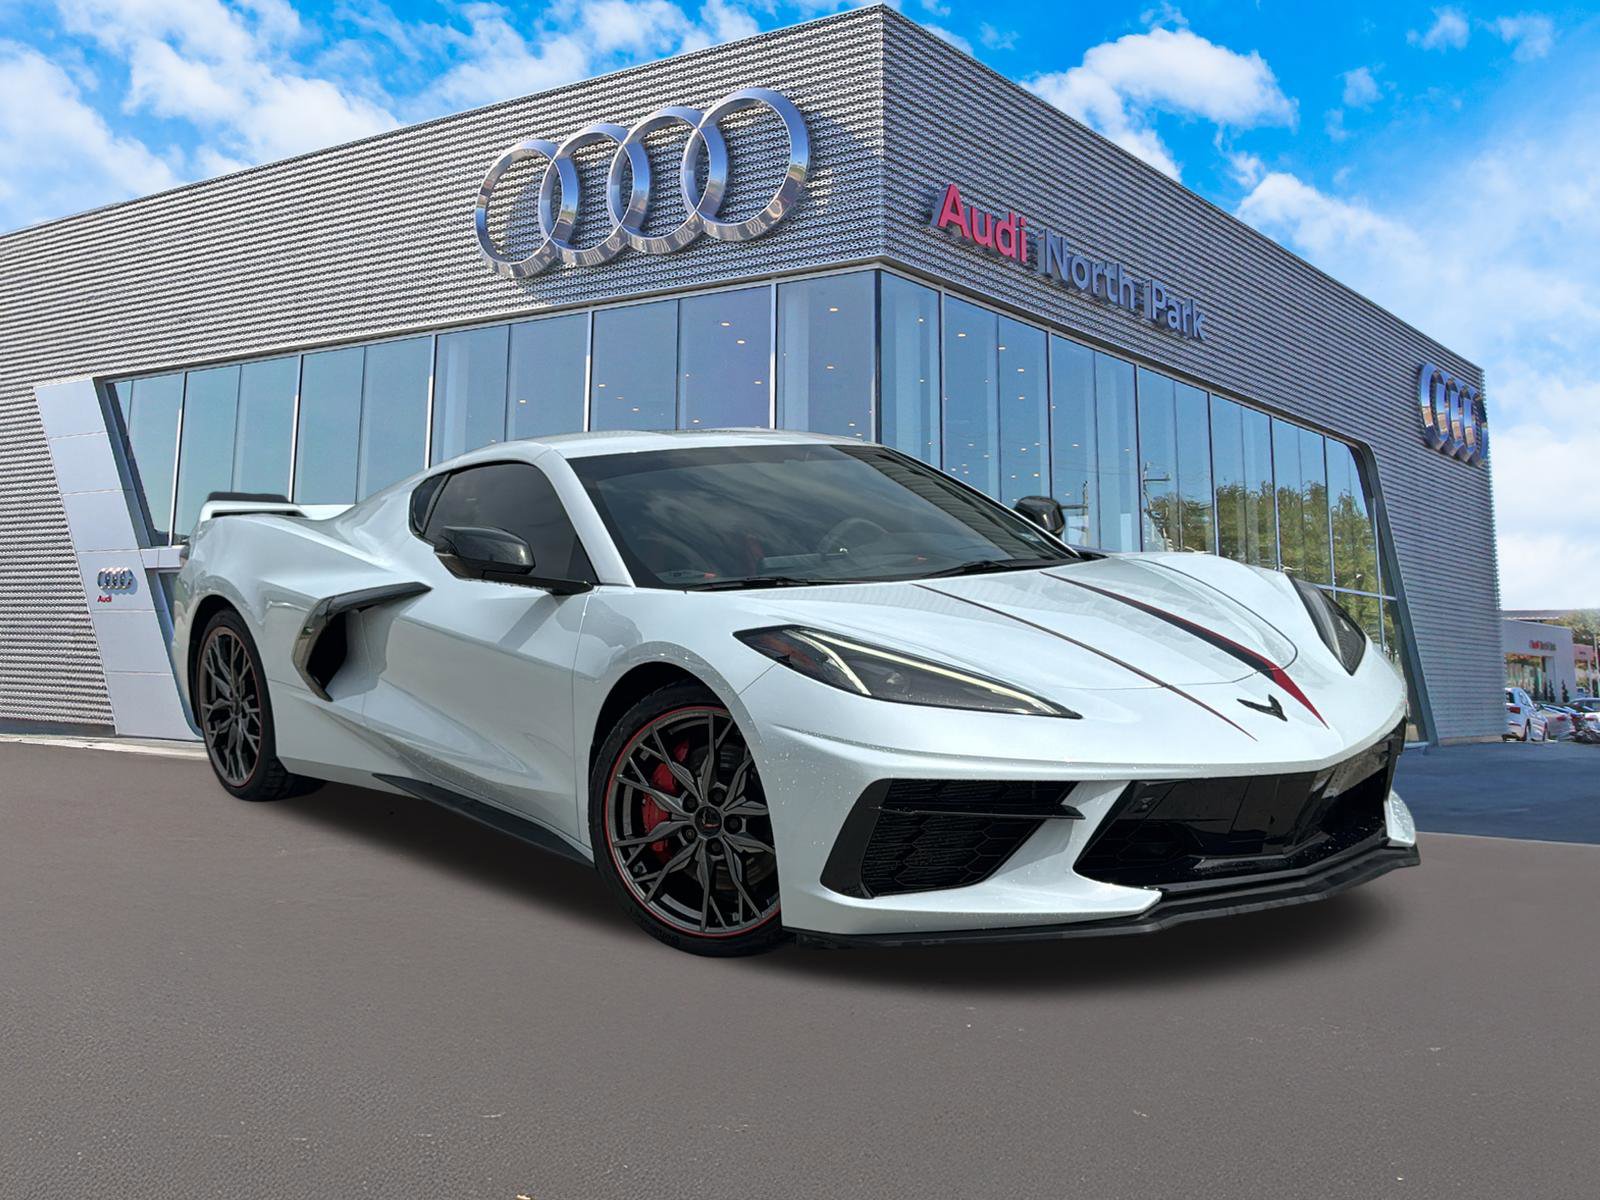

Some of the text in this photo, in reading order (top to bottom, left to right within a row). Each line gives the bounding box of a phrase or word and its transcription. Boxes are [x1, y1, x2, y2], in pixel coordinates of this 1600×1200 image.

[935, 183, 1206, 341] Audi North Park
